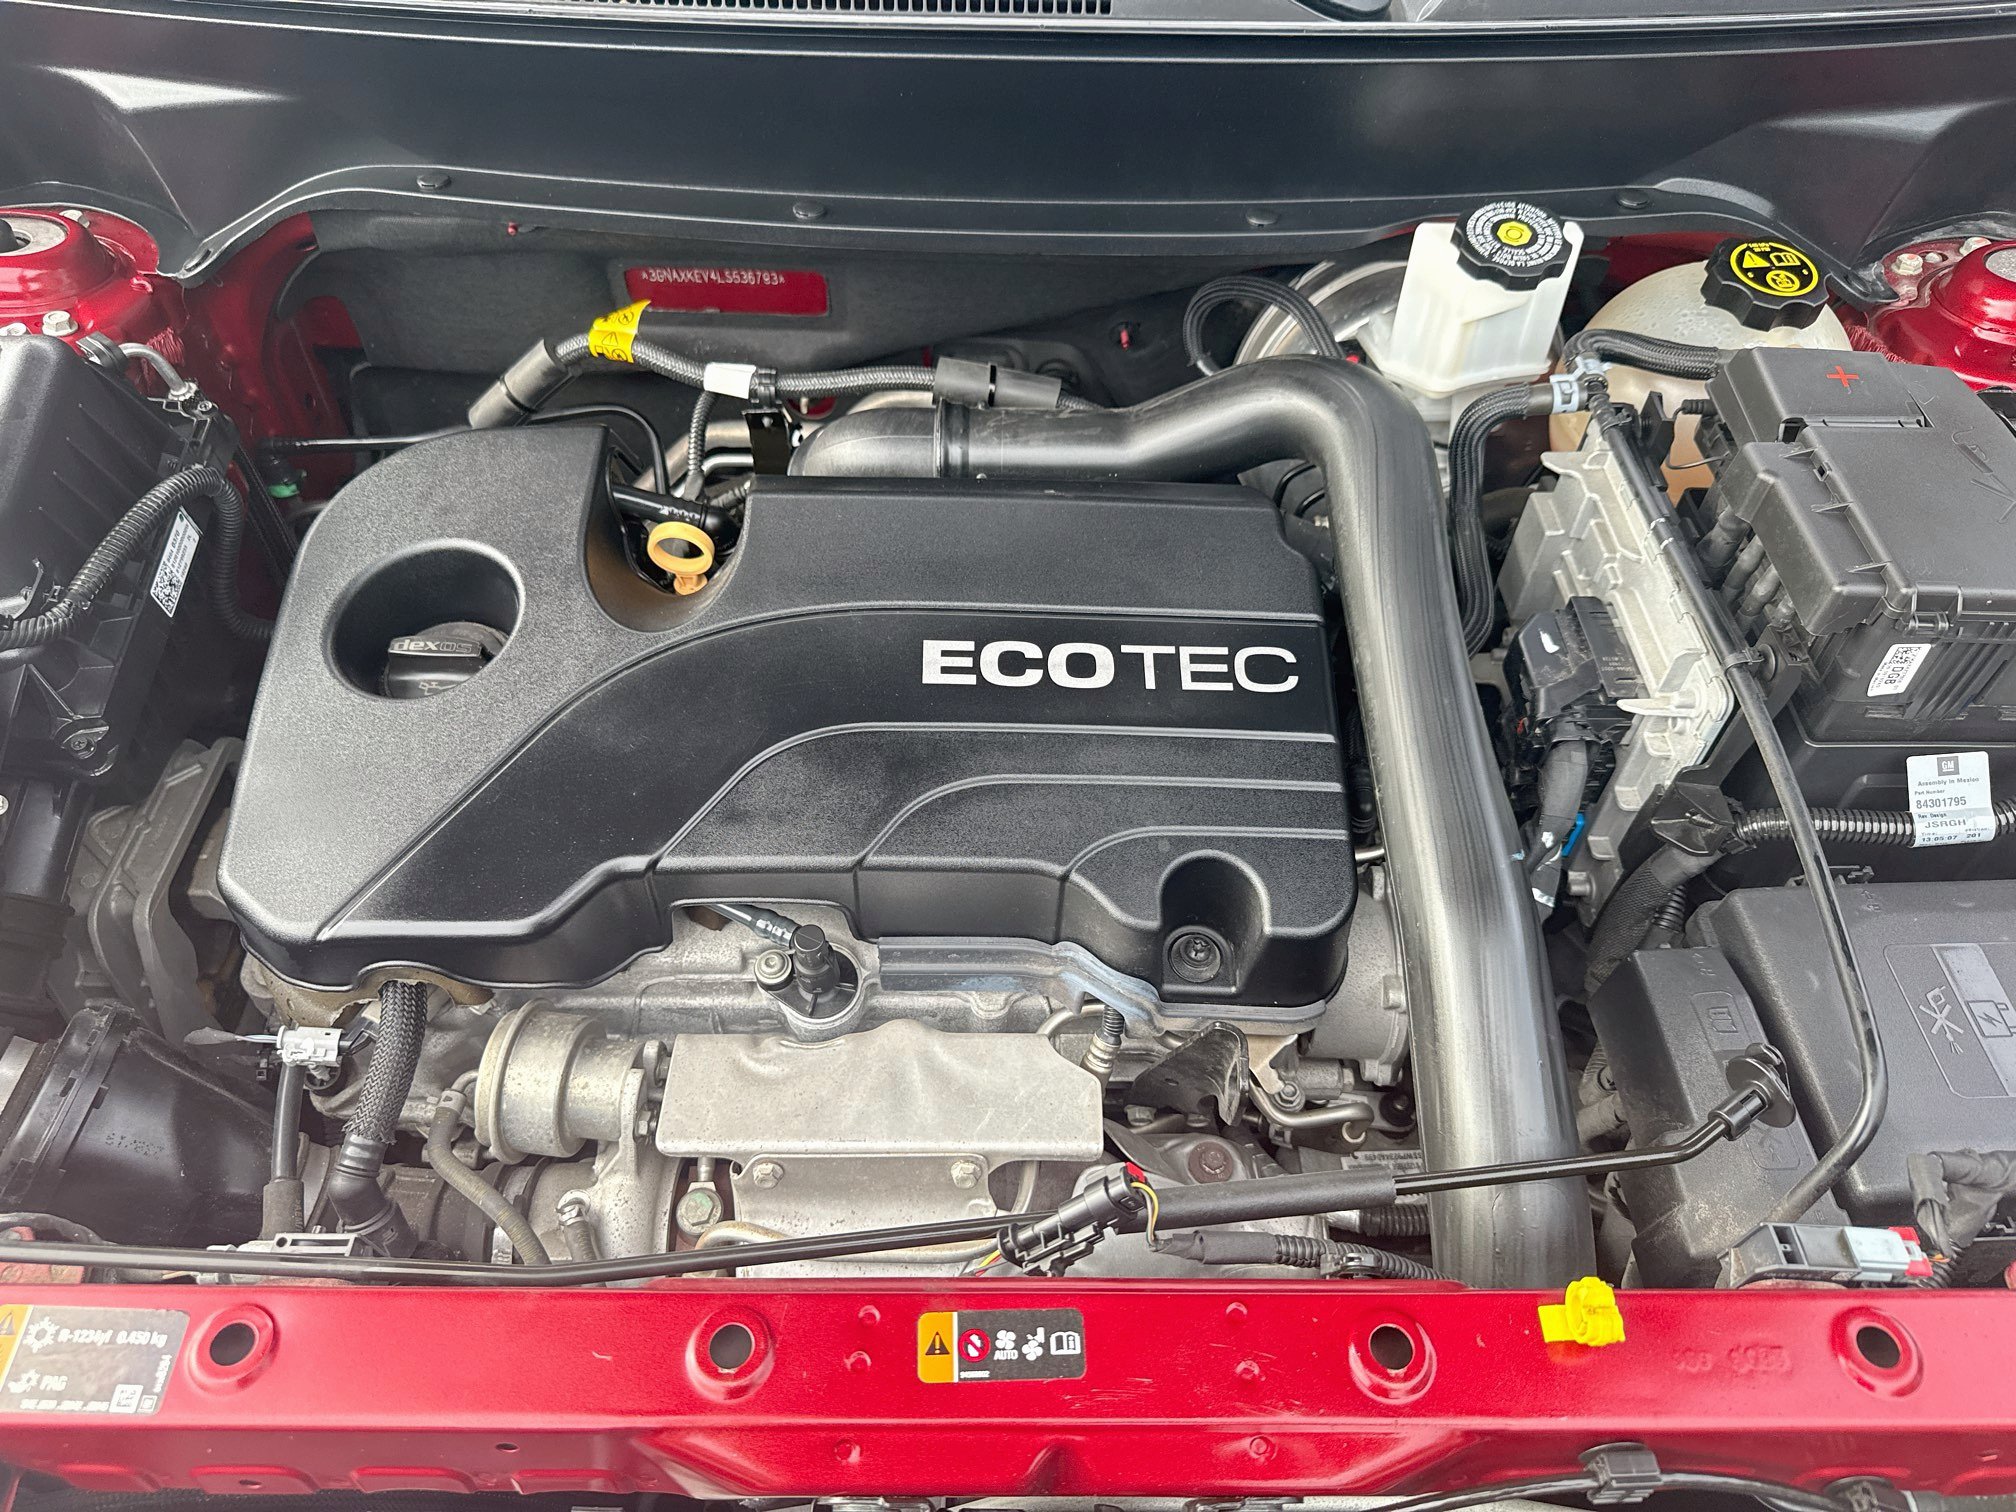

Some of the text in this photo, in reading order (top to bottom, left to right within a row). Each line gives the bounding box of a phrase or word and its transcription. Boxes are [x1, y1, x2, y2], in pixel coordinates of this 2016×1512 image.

[393, 639, 473, 653] dexos
[921, 639, 1300, 693] ECOTEC
[1884, 666, 1905, 685] DGB
[1941, 760, 1955, 772] GM
[1916, 796, 1967, 809] 84301795
[1924, 819, 1966, 829] JSRGH
[150, 1331, 168, 1348] kg
[993, 1349, 1019, 1361] AUTO
[39, 1375, 68, 1392] PAG
